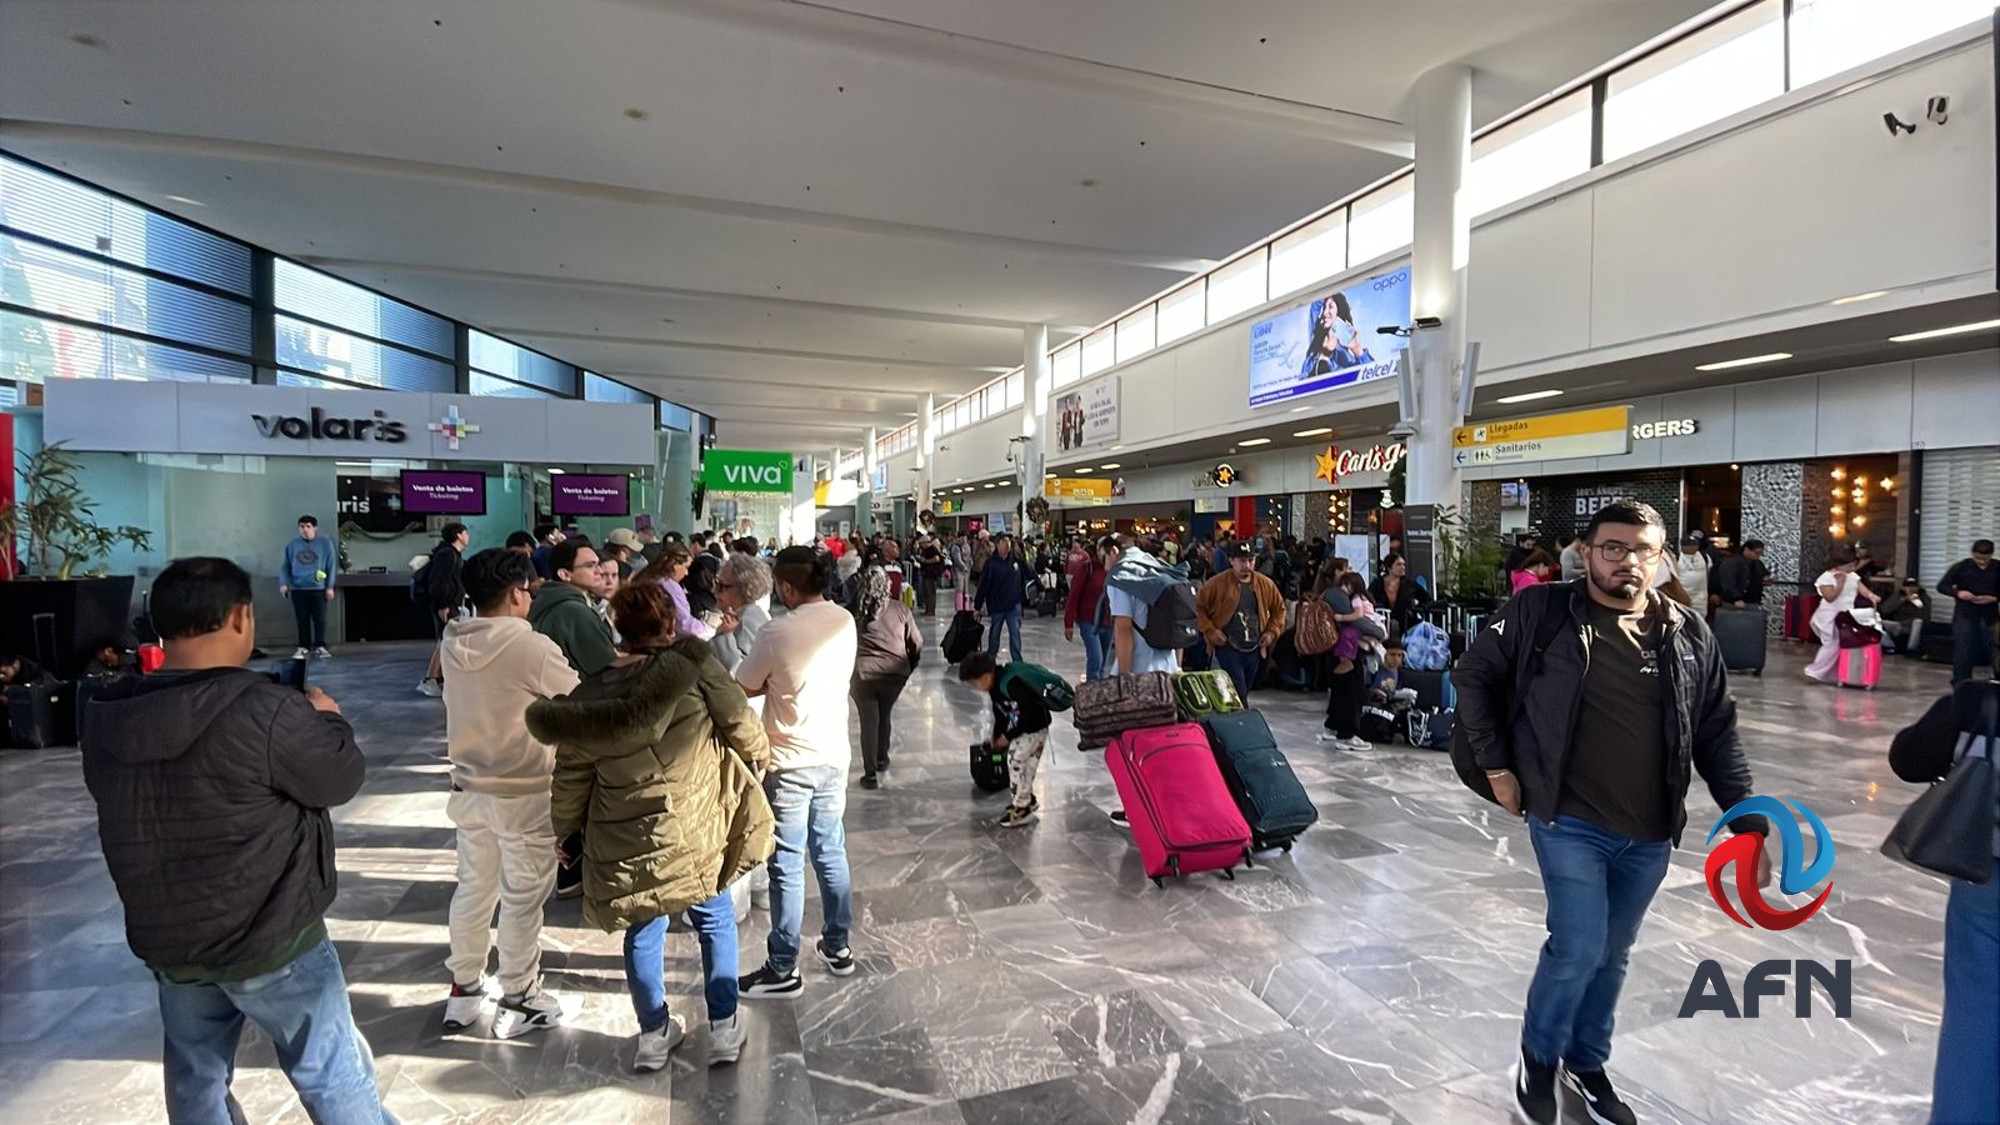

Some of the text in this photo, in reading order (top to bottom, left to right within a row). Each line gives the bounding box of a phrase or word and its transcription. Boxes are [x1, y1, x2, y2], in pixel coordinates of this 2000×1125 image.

[1373, 272, 1407, 291] oppo
[1361, 360, 1394, 380] telcel
[251, 406, 407, 443] volaris
[1489, 421, 1528, 434] Llegadas
[1495, 441, 1541, 453] Sanitarios
[1336, 444, 1382, 476] Carl's
[412, 484, 474, 494] Venta de boletos
[562, 486, 619, 496] Venta de boletos
